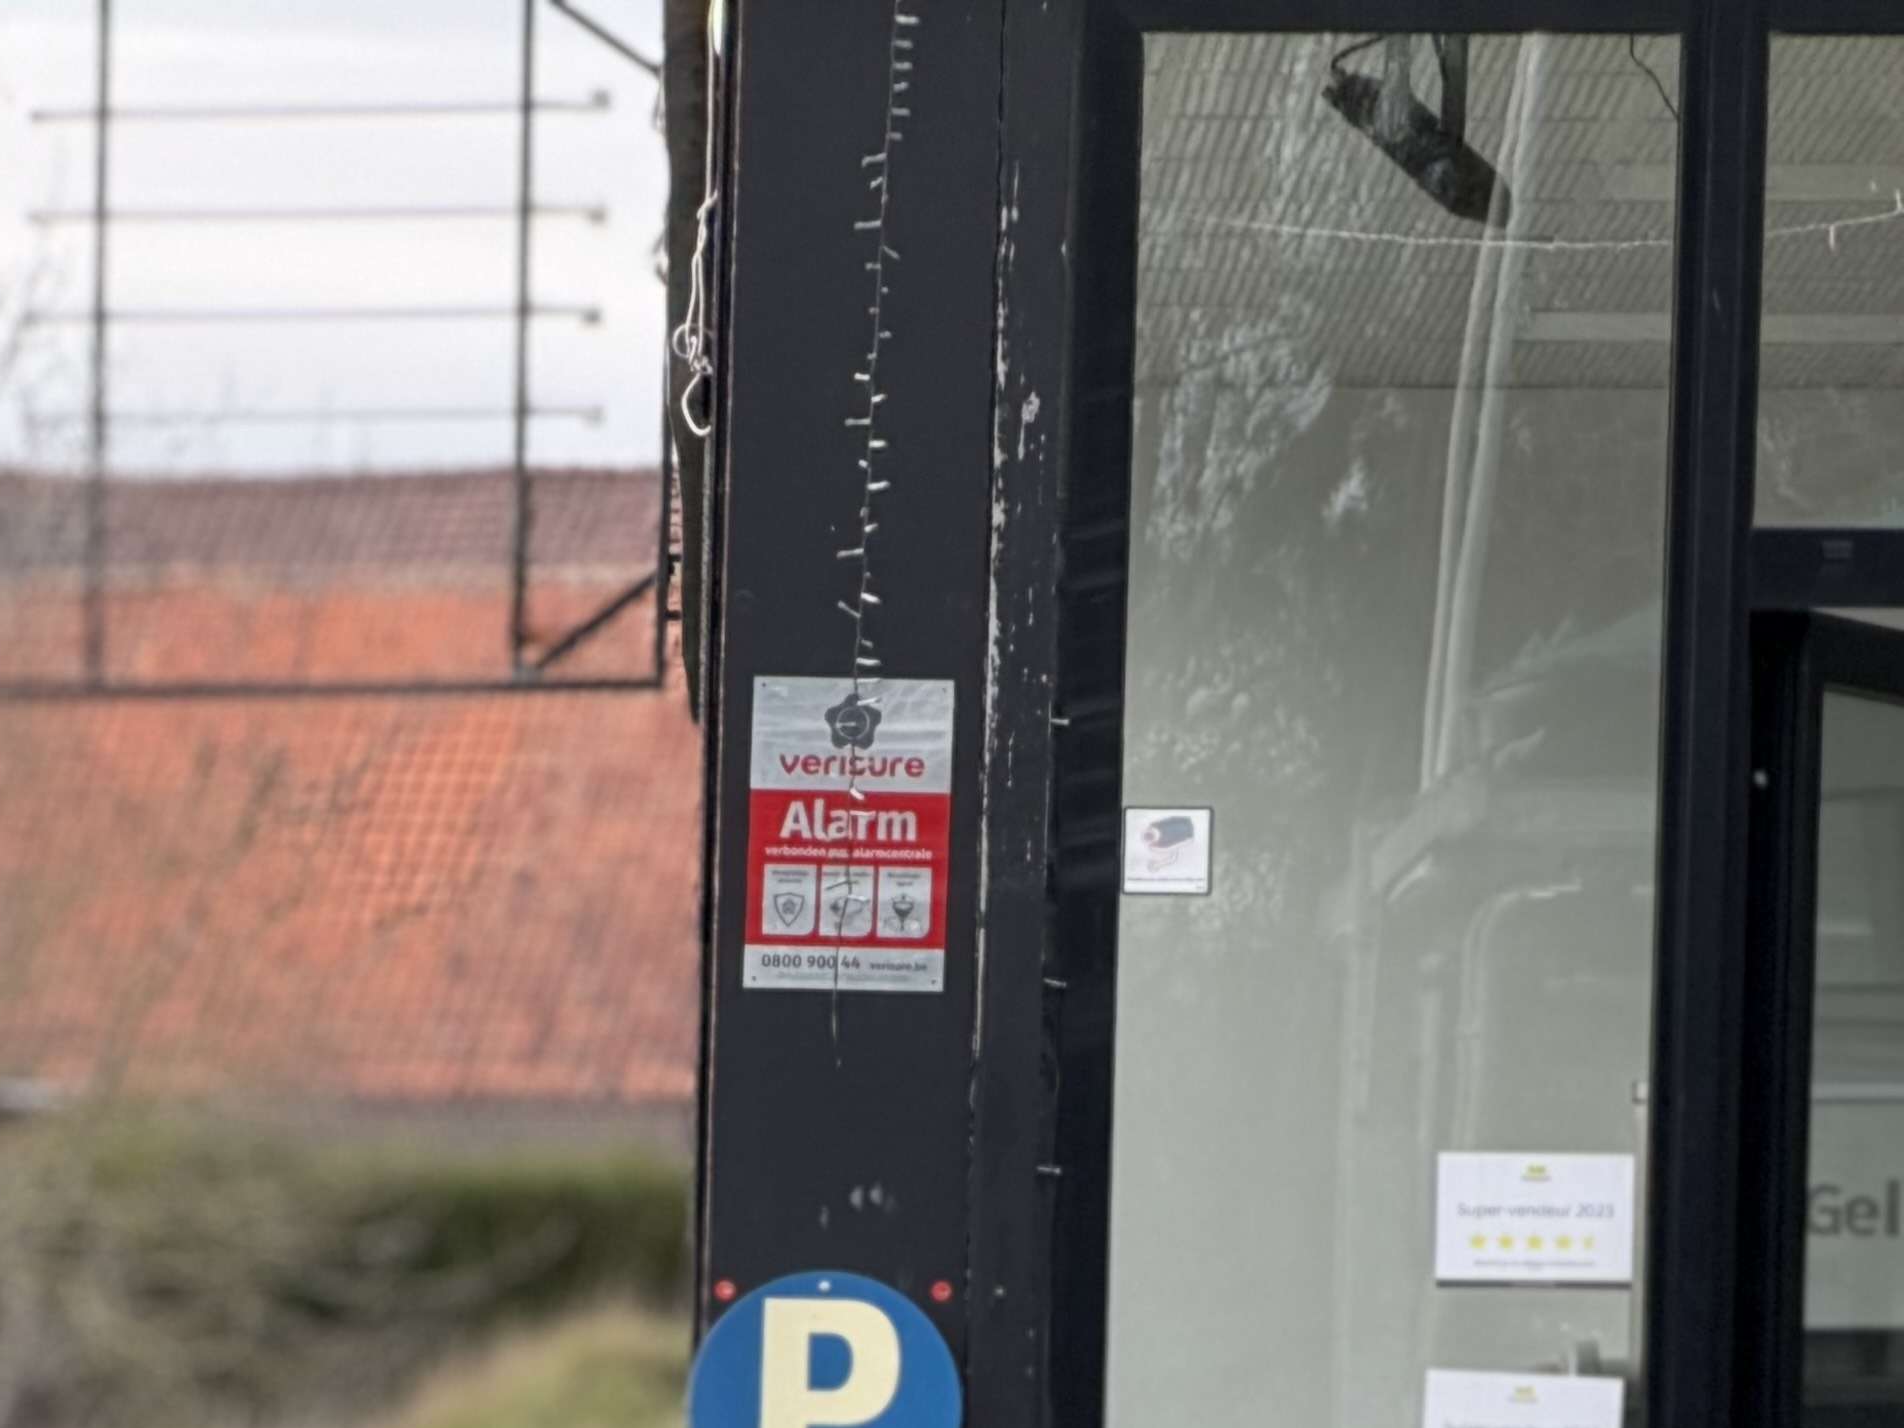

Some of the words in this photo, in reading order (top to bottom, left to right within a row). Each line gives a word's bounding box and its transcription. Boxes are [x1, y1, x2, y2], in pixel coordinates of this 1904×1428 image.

[779, 752, 926, 779] verisure
[778, 797, 917, 843] Alarm
[765, 844, 826, 858] verbonden
[761, 953, 802, 968] 0800
[806, 954, 837, 970] 900
[840, 955, 861, 970] 44
